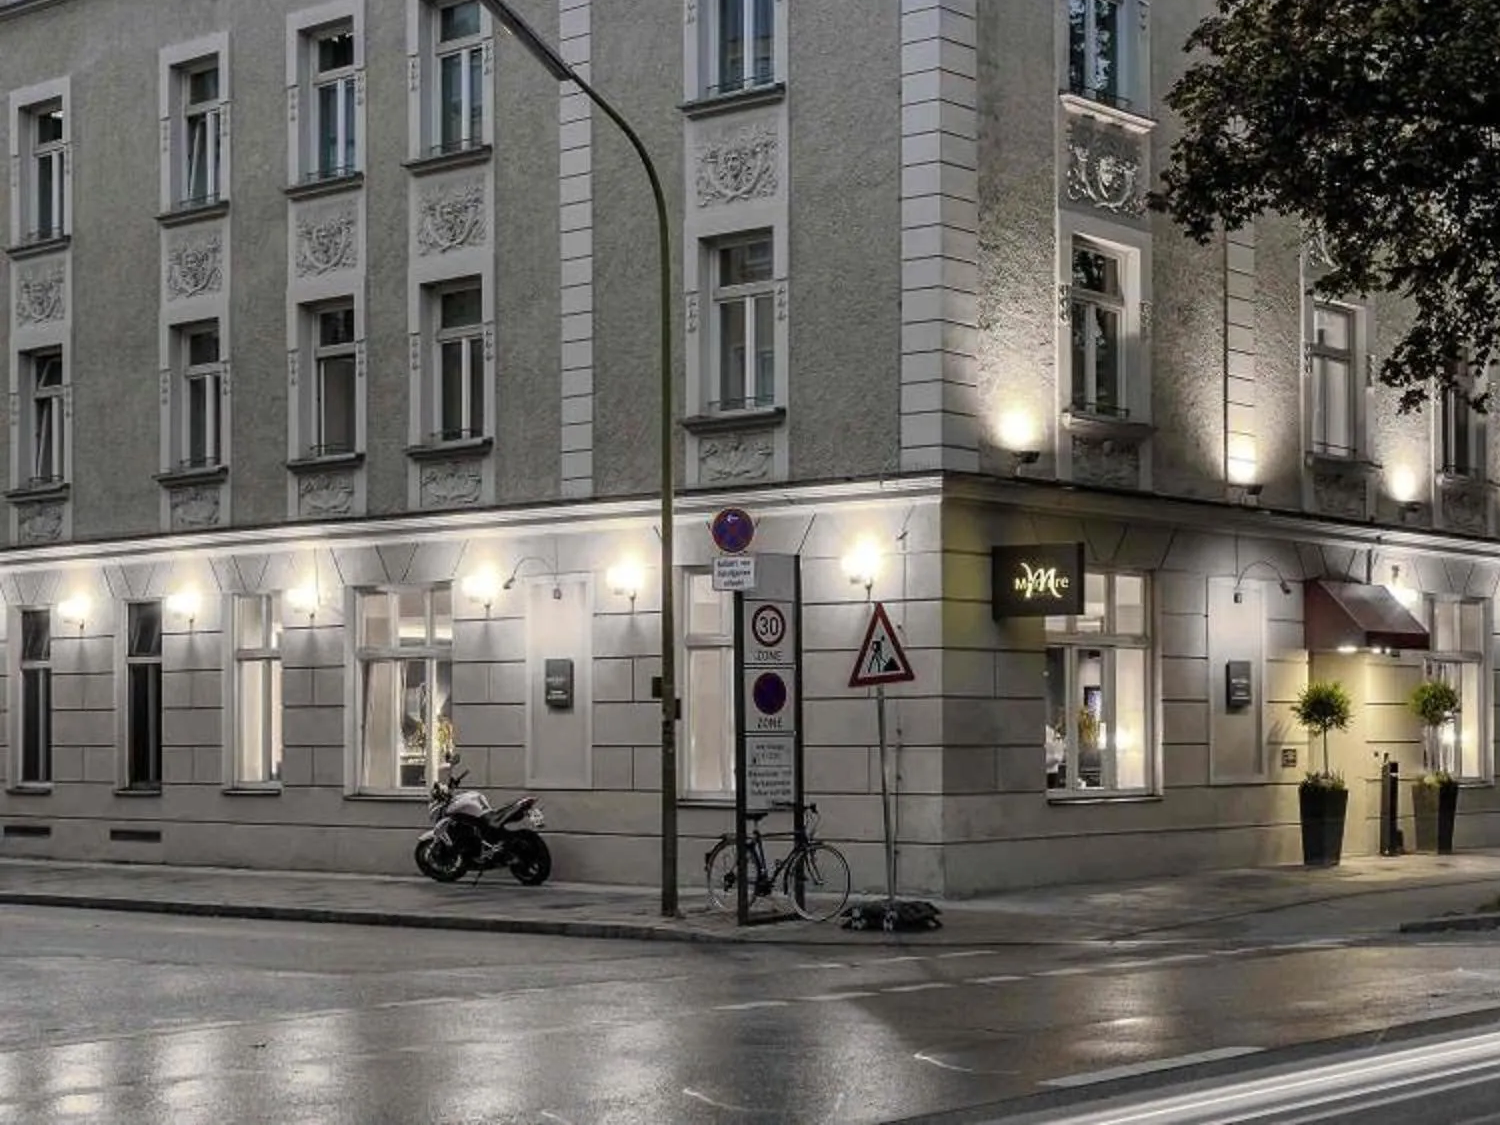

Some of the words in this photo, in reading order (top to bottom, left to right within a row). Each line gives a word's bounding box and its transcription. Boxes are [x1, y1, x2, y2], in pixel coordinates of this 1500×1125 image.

[759, 616, 779, 636] 30
[756, 650, 783, 661] ZONE
[757, 716, 784, 729] ZONE
